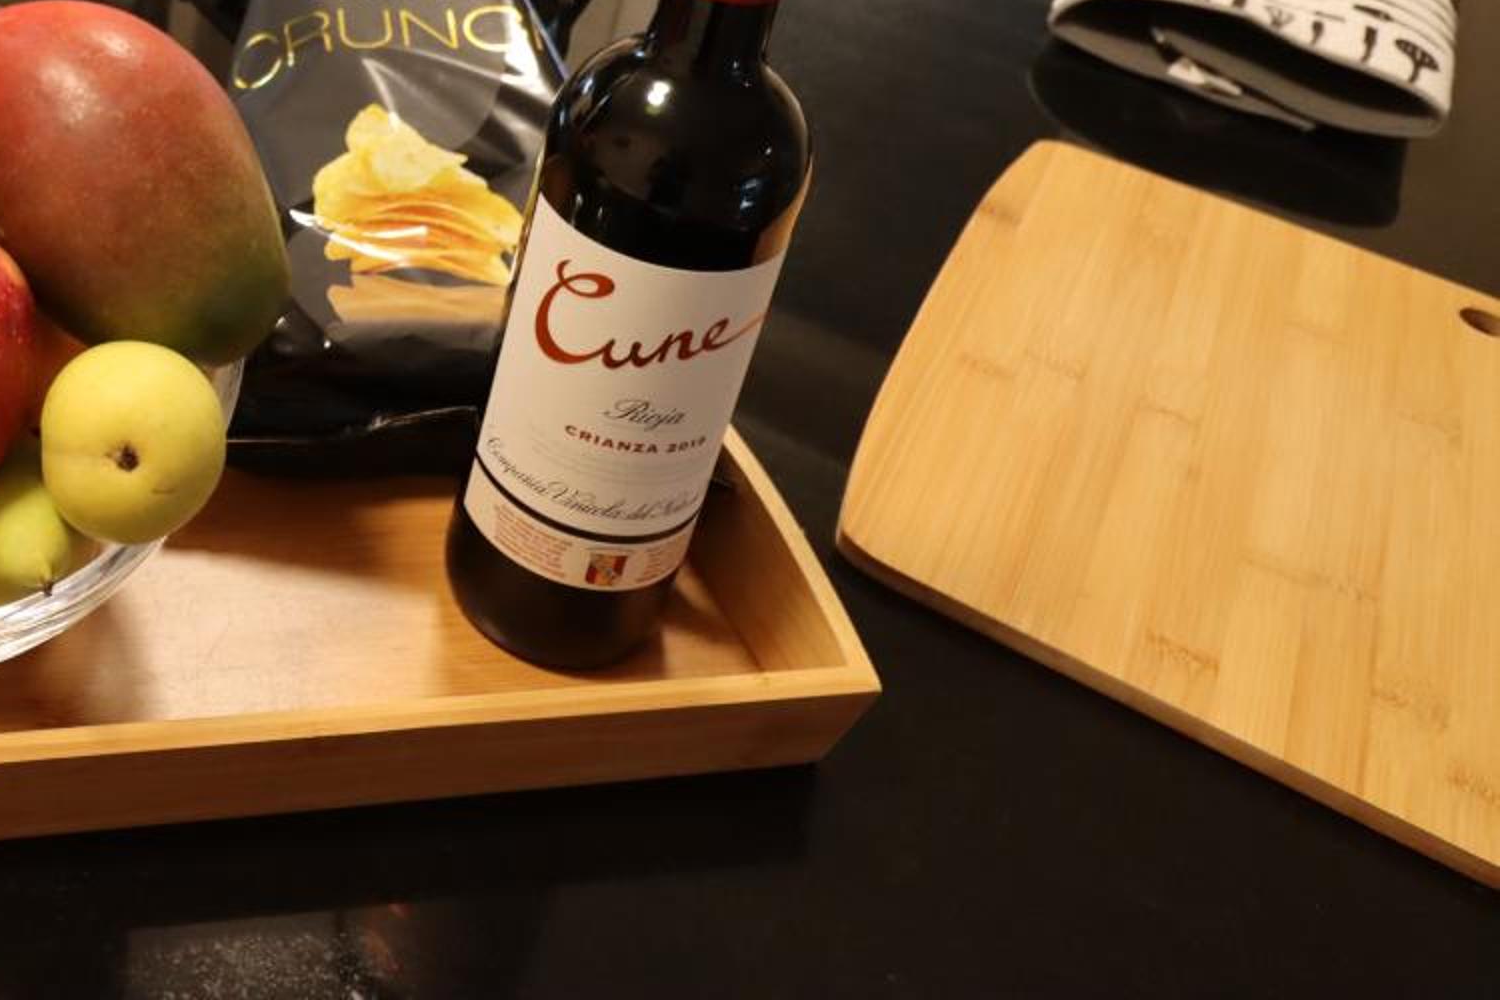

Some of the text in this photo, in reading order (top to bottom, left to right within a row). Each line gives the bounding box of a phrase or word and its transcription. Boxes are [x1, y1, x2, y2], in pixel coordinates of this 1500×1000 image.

[535, 259, 764, 369] Cune
[603, 398, 686, 431] Rioja
[564, 424, 658, 453] CRIANZA
